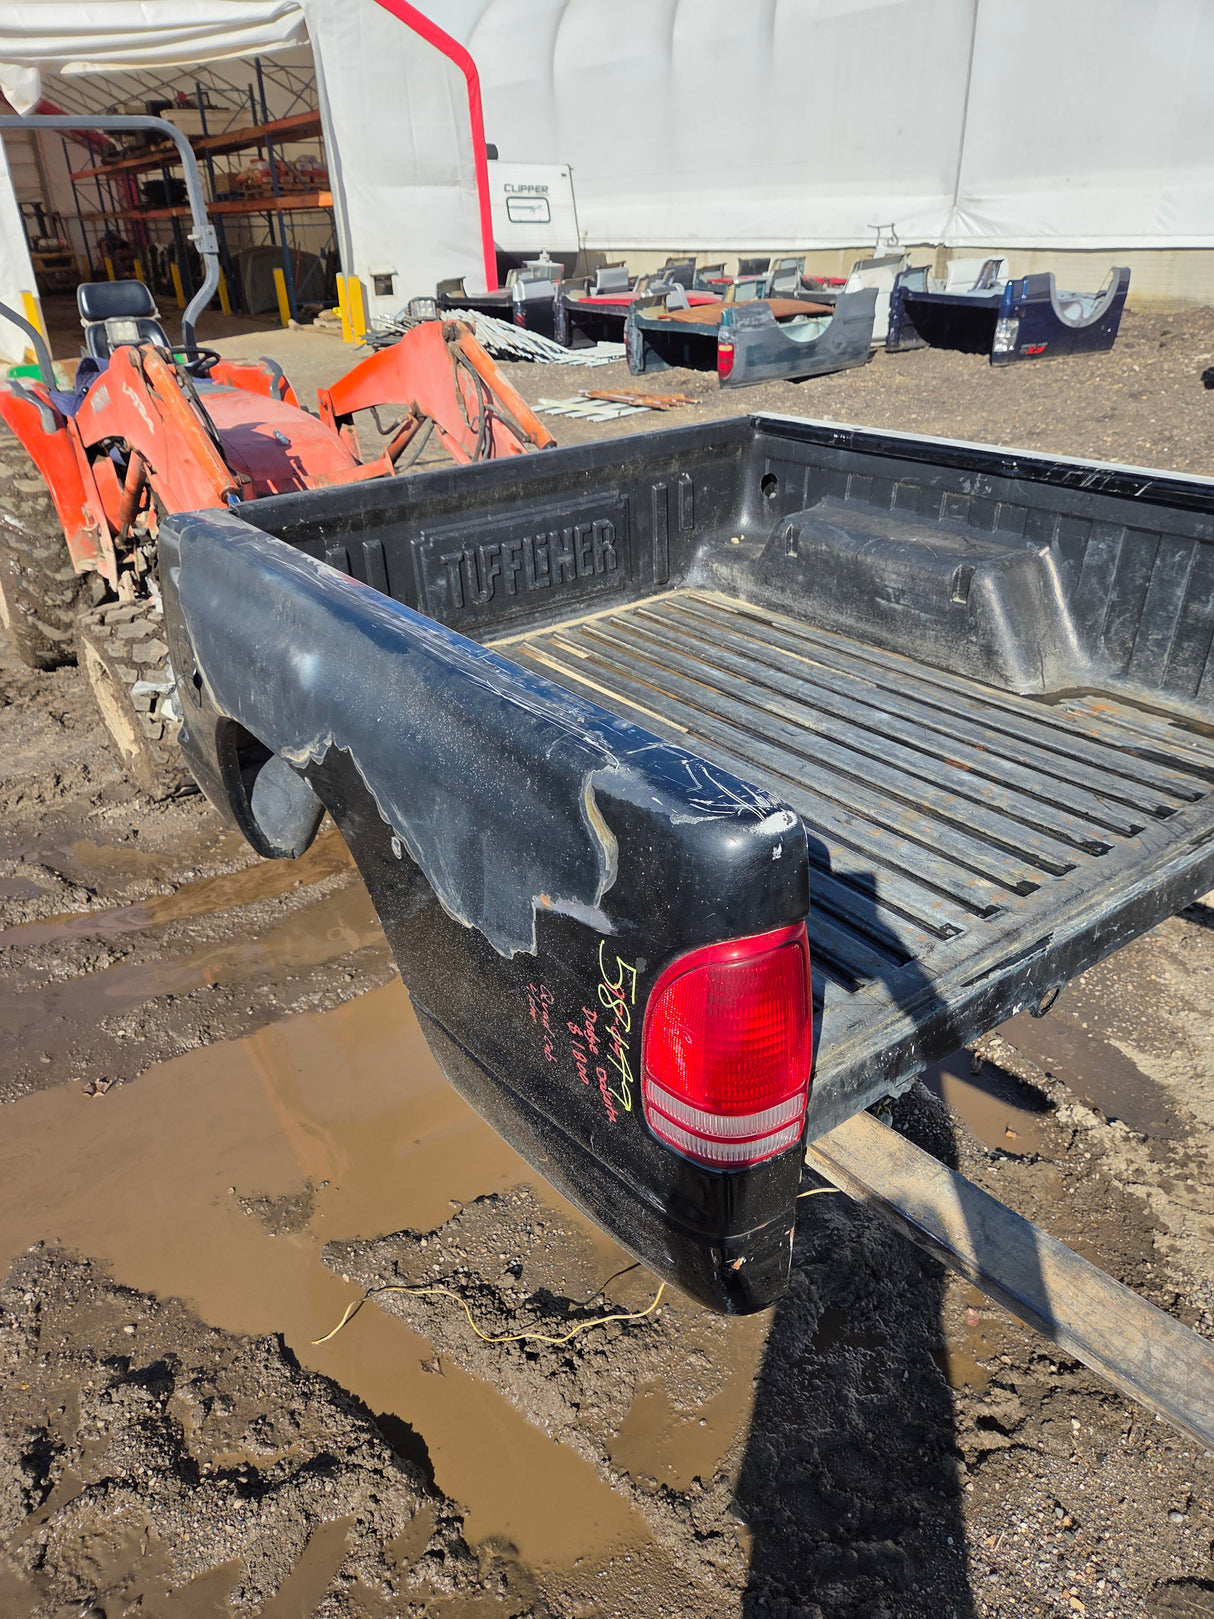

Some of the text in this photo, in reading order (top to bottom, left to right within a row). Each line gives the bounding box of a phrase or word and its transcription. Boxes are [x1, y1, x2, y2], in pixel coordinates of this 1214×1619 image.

[504, 184, 549, 193] CLIPPER
[540, 984, 556, 1038] Quad
[582, 1006, 619, 1123] Dodge Dakota
